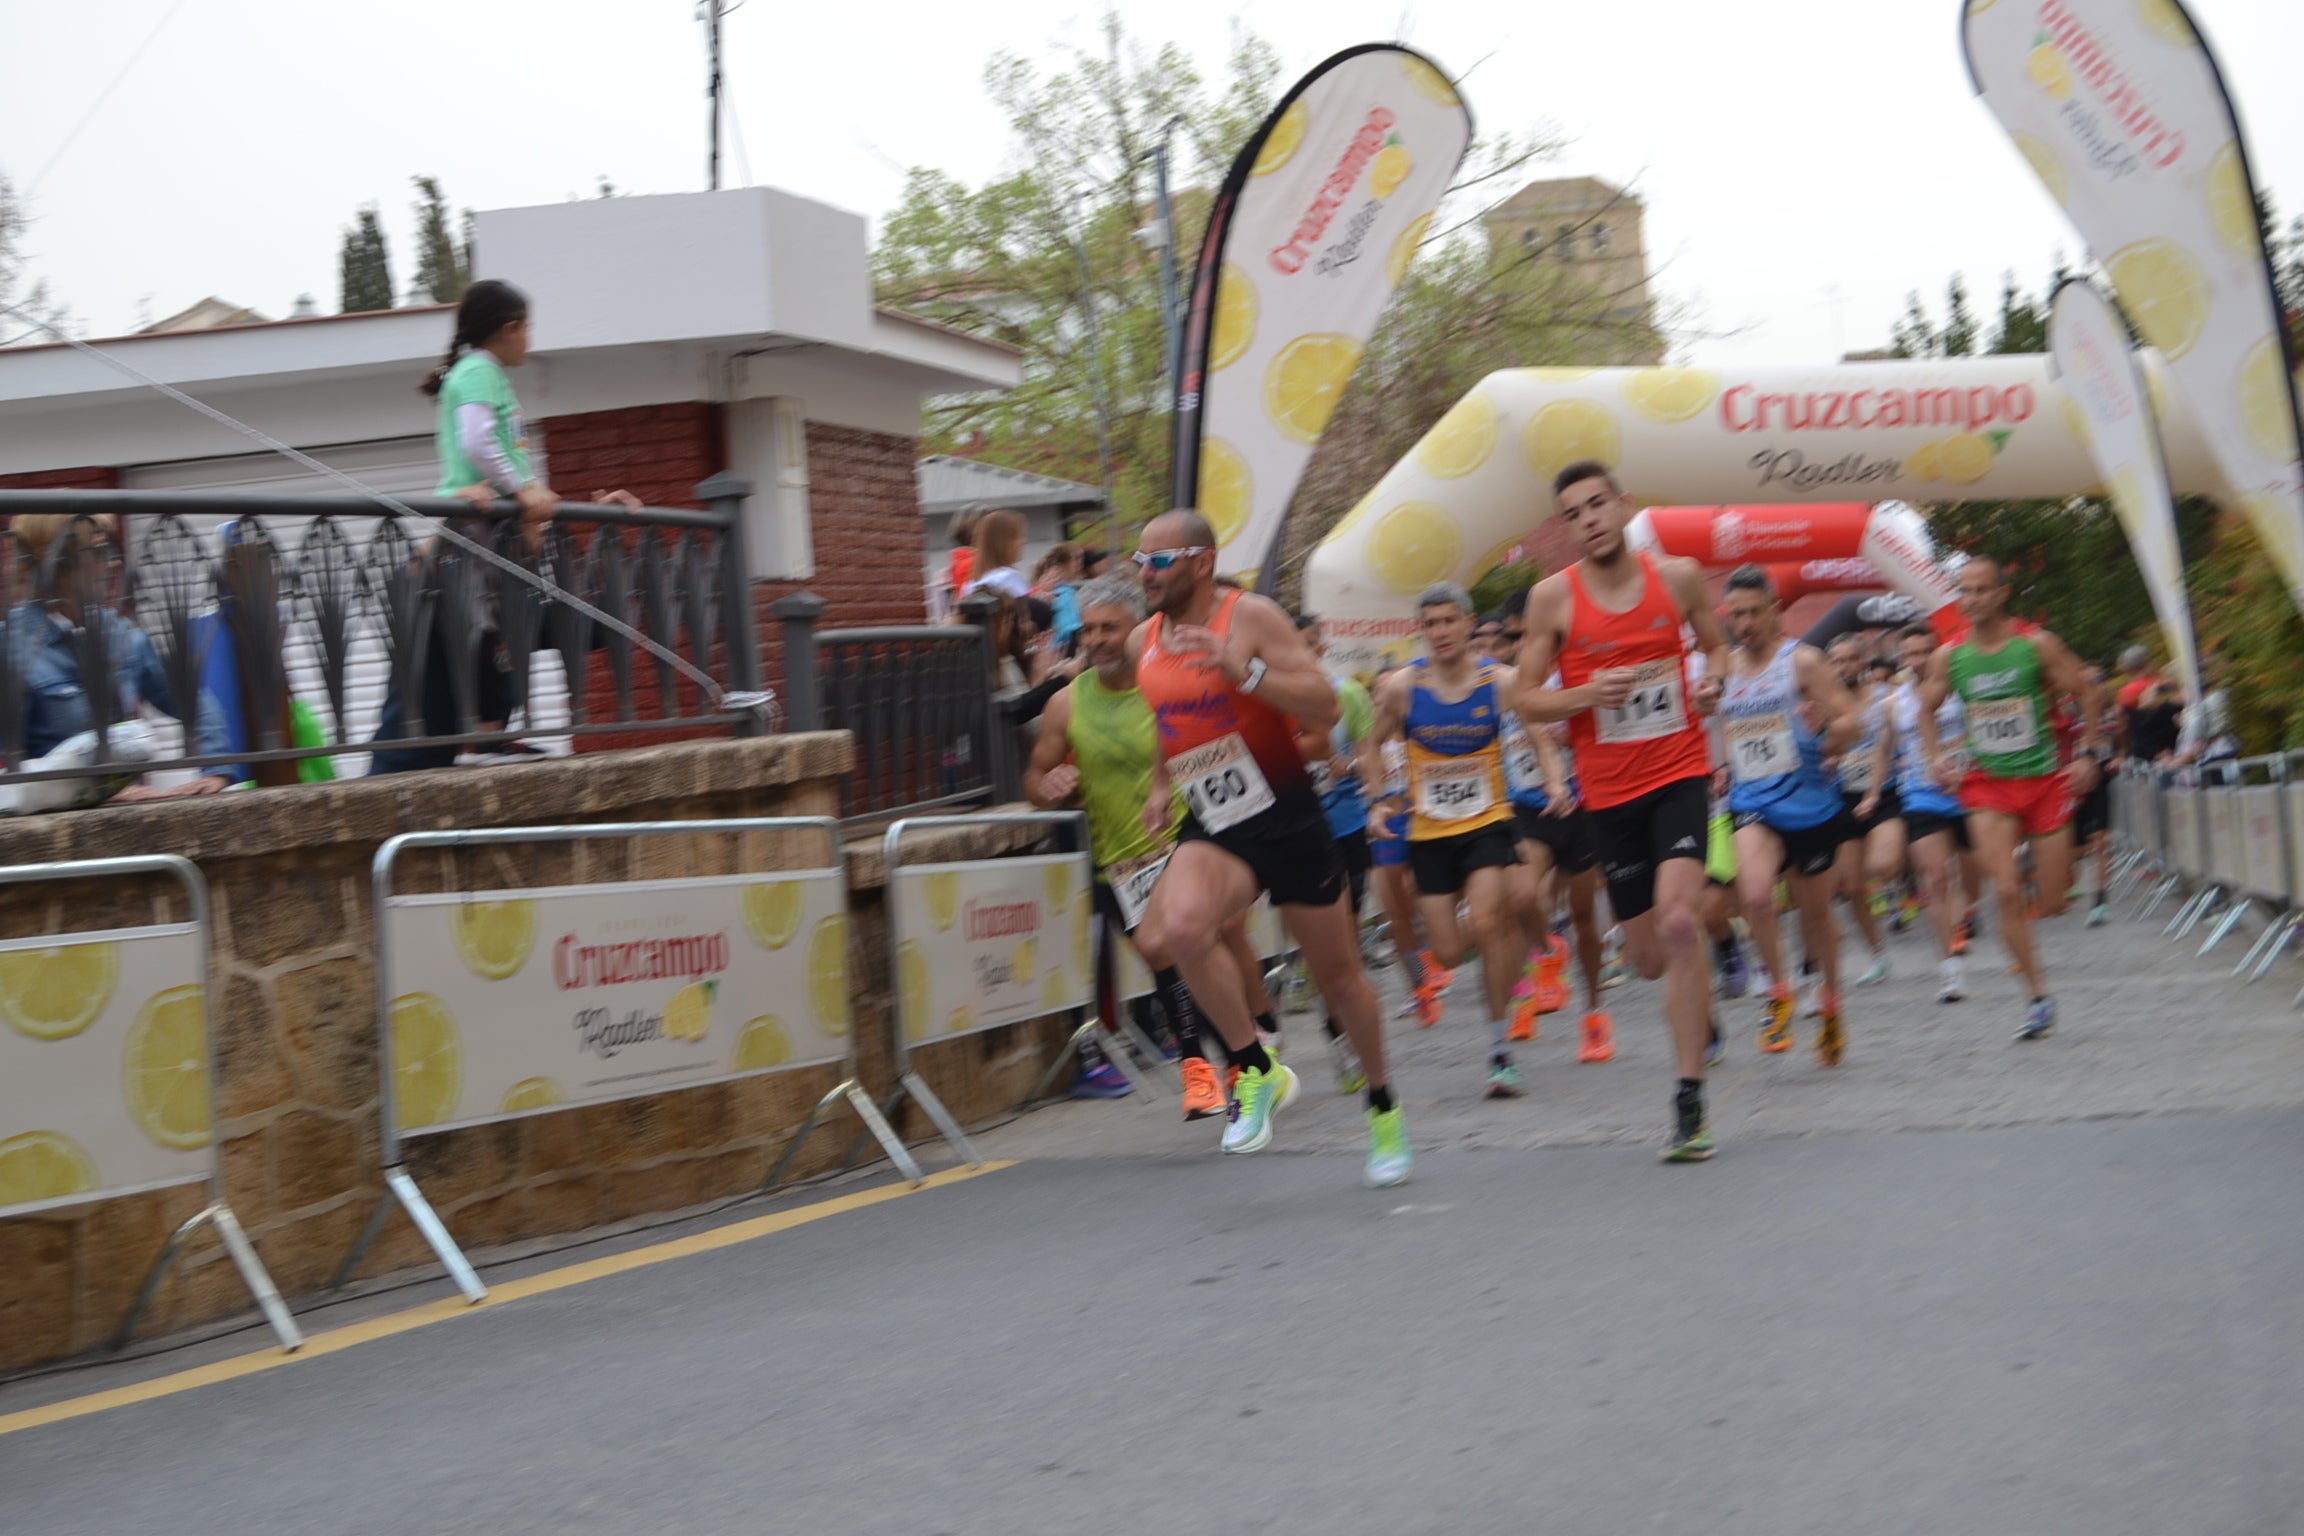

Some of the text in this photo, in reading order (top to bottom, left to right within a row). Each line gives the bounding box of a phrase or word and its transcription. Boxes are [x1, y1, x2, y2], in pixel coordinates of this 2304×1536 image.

[1268, 106, 1395, 275] Cruzcampo
[1720, 381, 2035, 433] Cruzcampo
[1748, 447, 1904, 492] Radler
[554, 931, 729, 991] Cruzcampo
[573, 1005, 665, 1059] Radler
